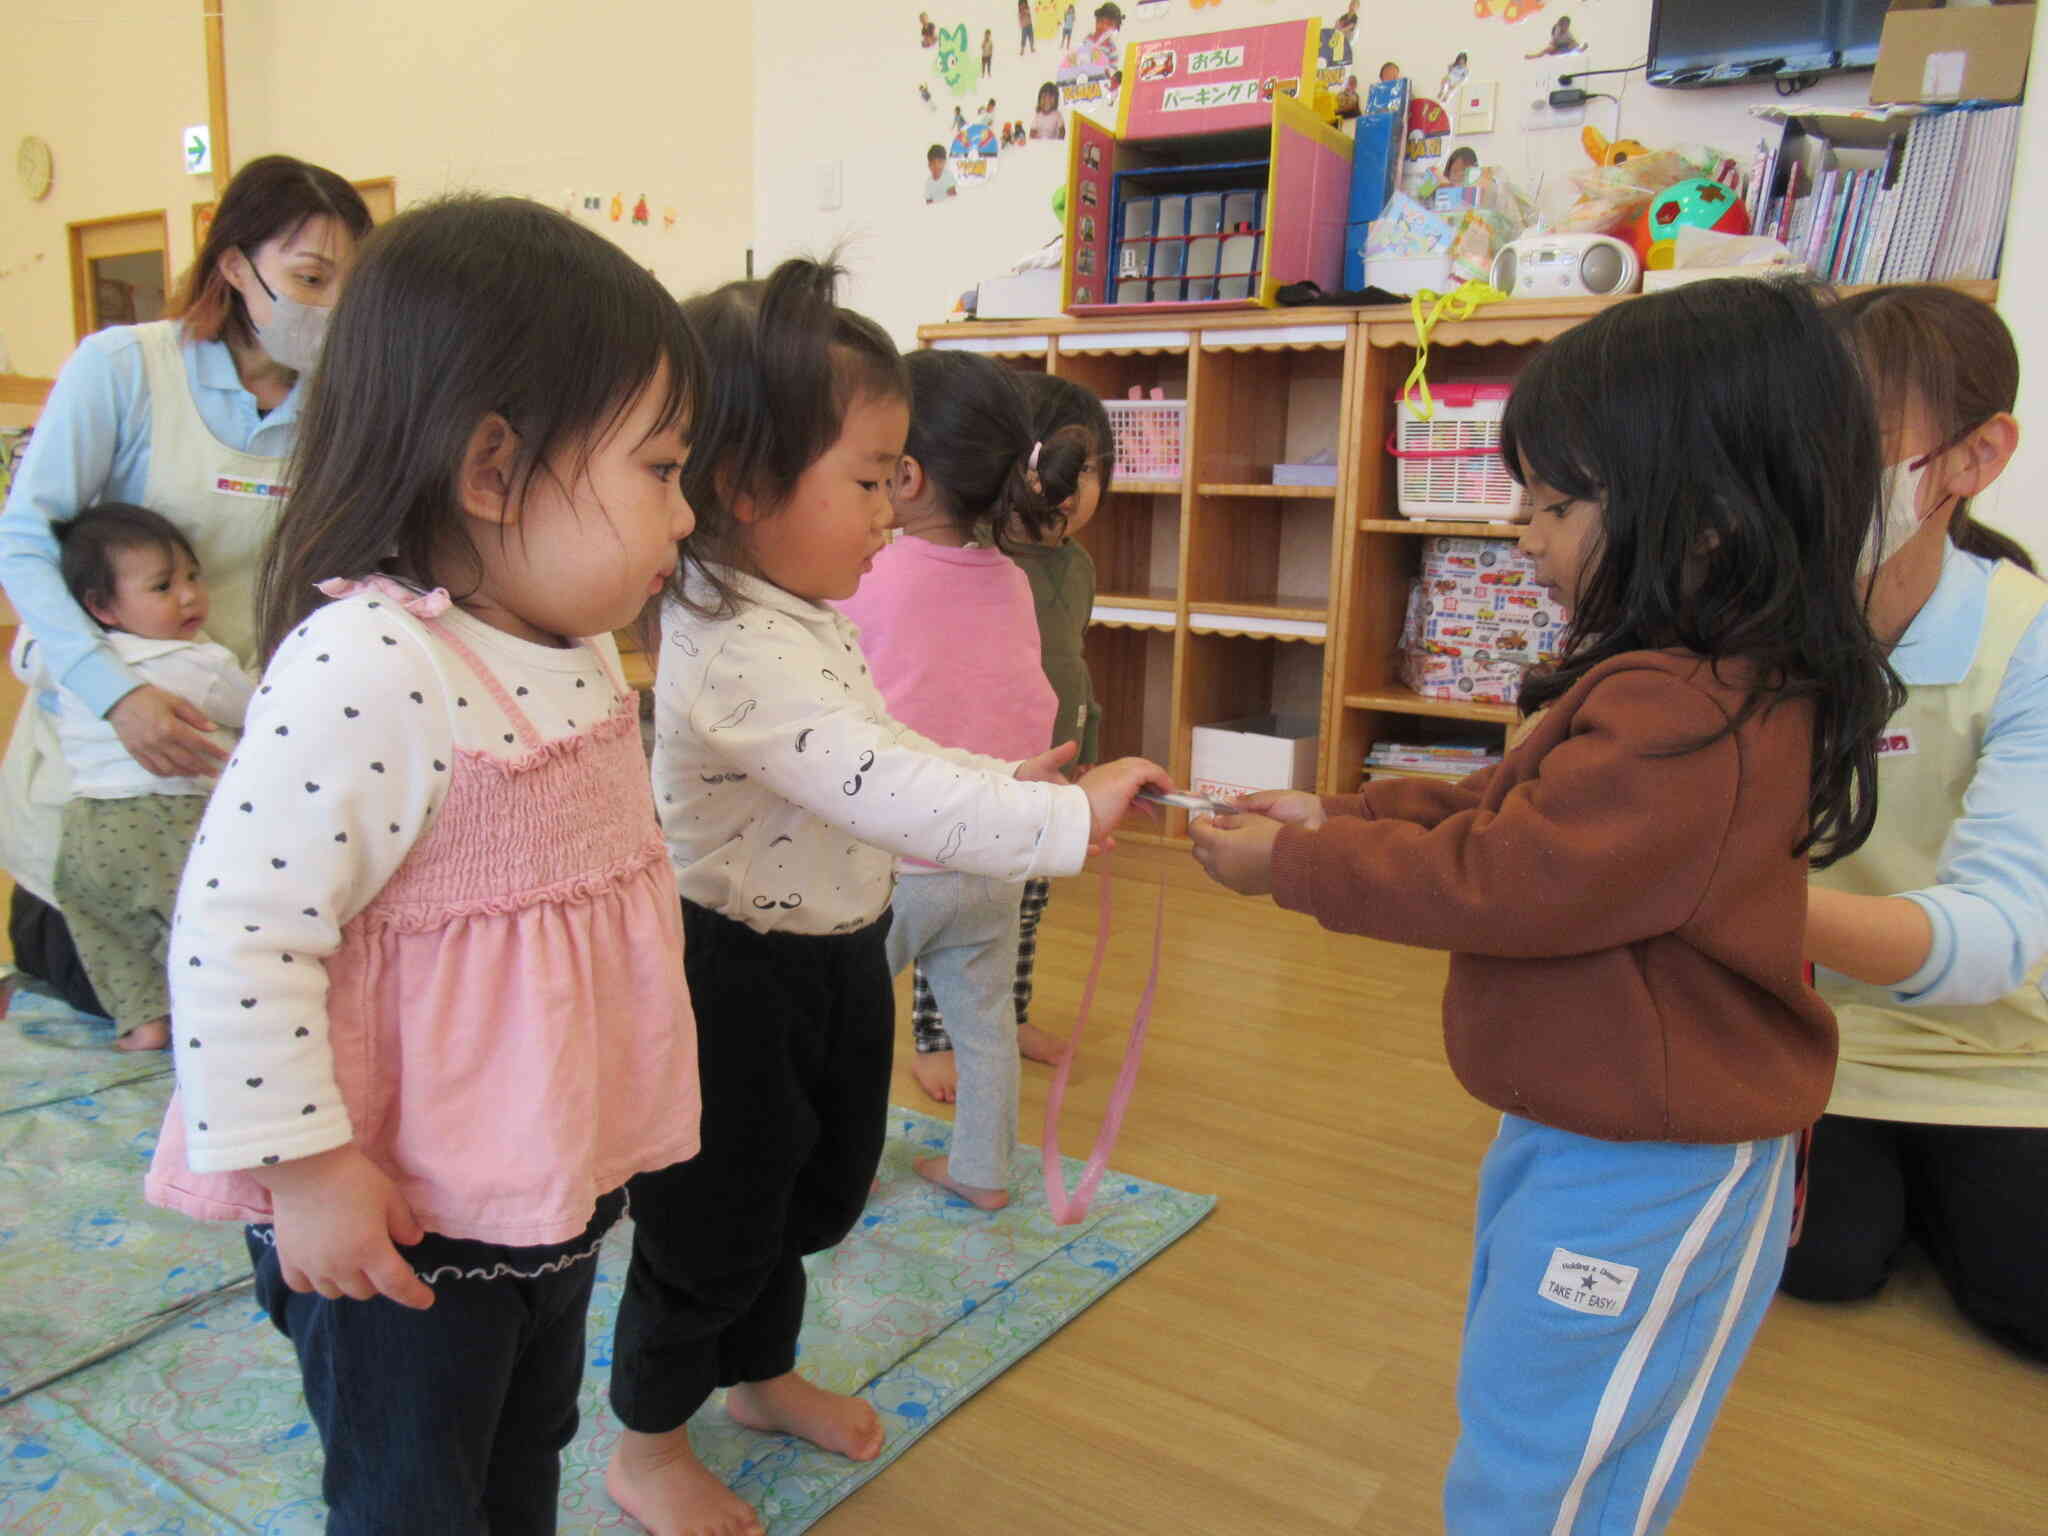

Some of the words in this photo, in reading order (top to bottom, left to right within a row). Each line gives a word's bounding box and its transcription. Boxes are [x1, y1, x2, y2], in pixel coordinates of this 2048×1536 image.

[1191, 49, 1240, 71] おろし
[1548, 1280, 1573, 1300] TAKE
[1574, 1291, 1586, 1304] IT
